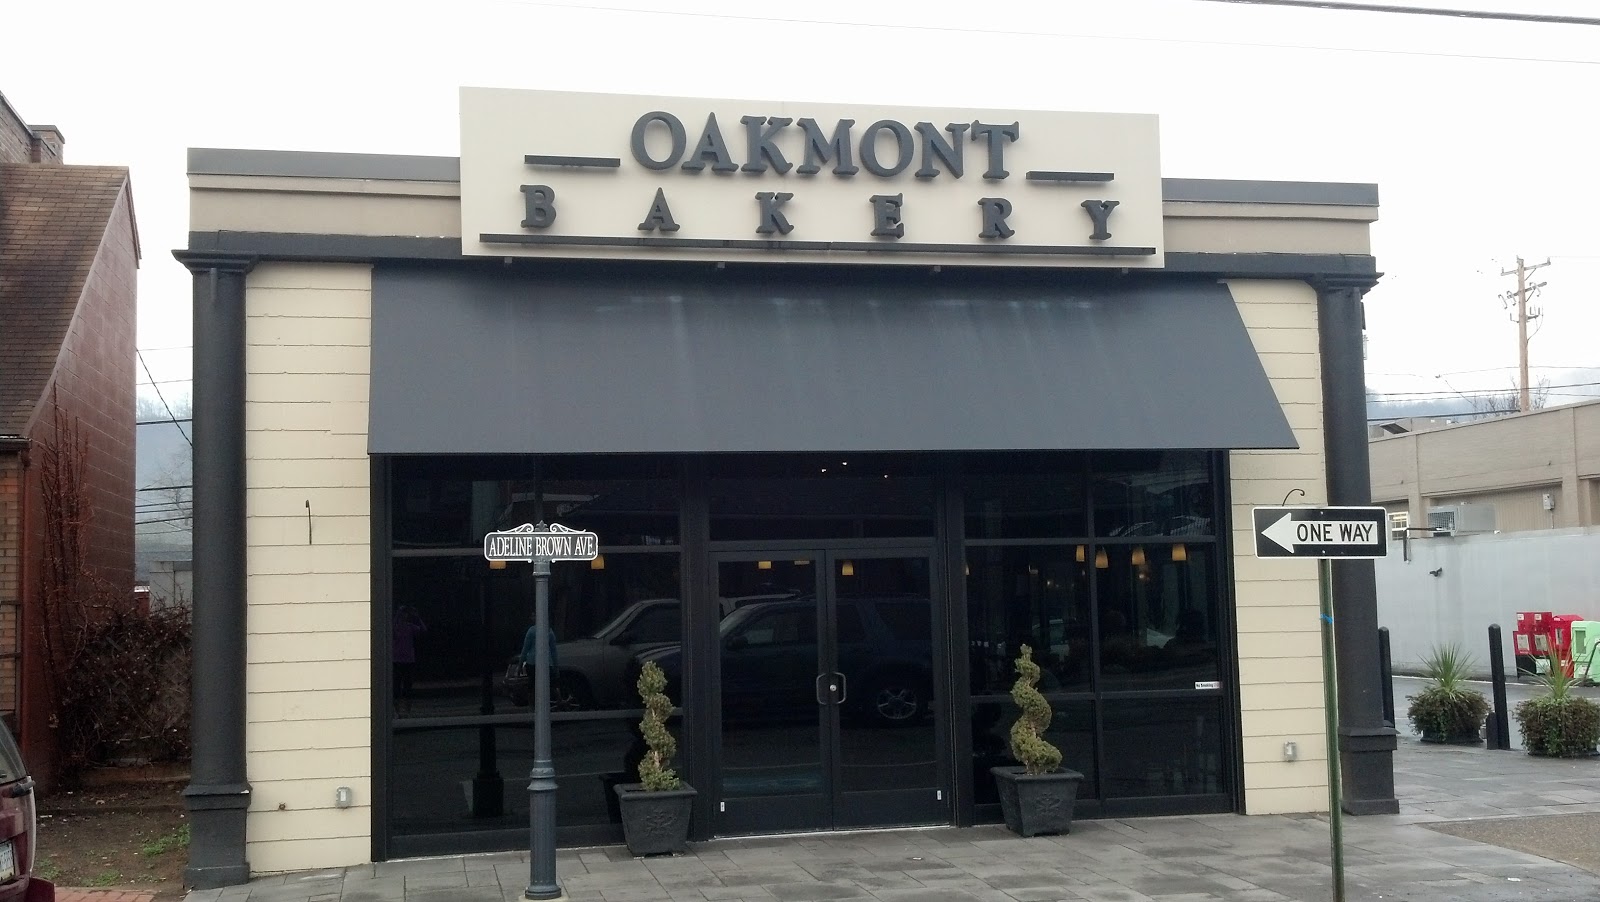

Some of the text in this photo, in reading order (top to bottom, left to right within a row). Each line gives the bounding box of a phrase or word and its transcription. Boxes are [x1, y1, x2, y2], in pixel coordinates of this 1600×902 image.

[630, 111, 1020, 181] OAKMONT
[519, 184, 1119, 241] BAKERY
[489, 536, 596, 557] ADELINE BROWN AVE.
[1296, 523, 1373, 542] ONE WAY
